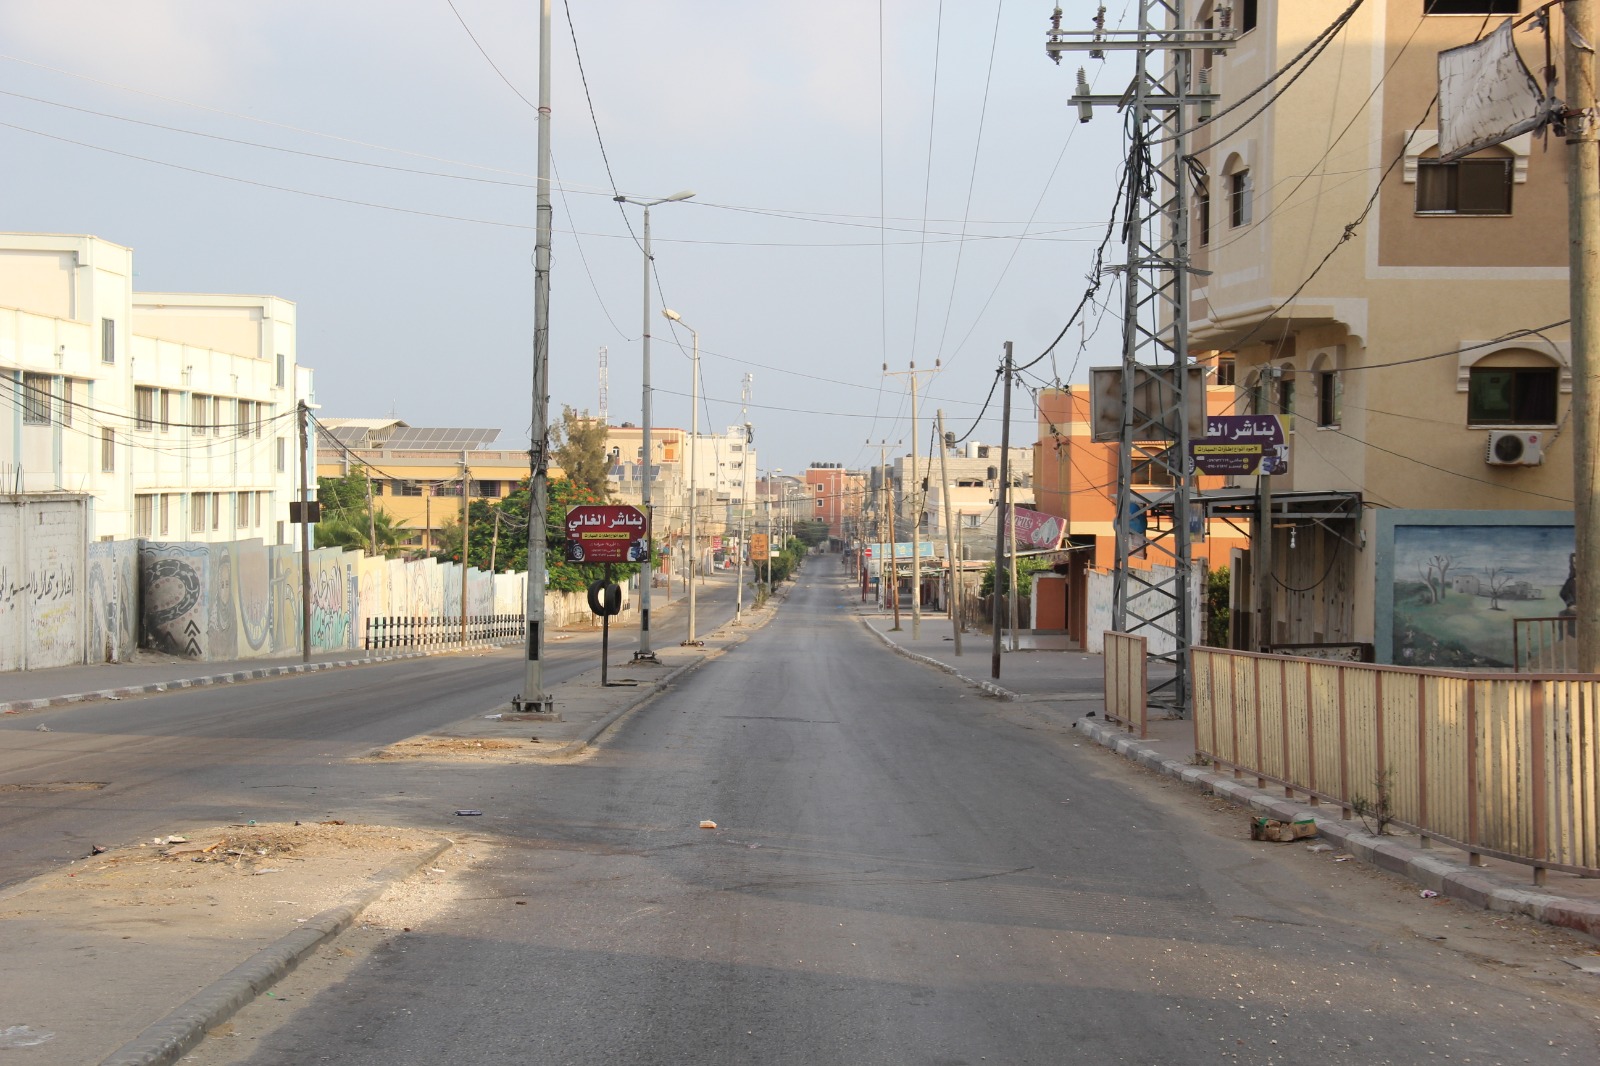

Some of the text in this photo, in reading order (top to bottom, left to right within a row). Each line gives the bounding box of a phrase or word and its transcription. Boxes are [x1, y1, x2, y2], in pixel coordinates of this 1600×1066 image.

[1207, 420, 1275, 441] بناشر الغ
[568, 512, 643, 531] بناشر الغالي
